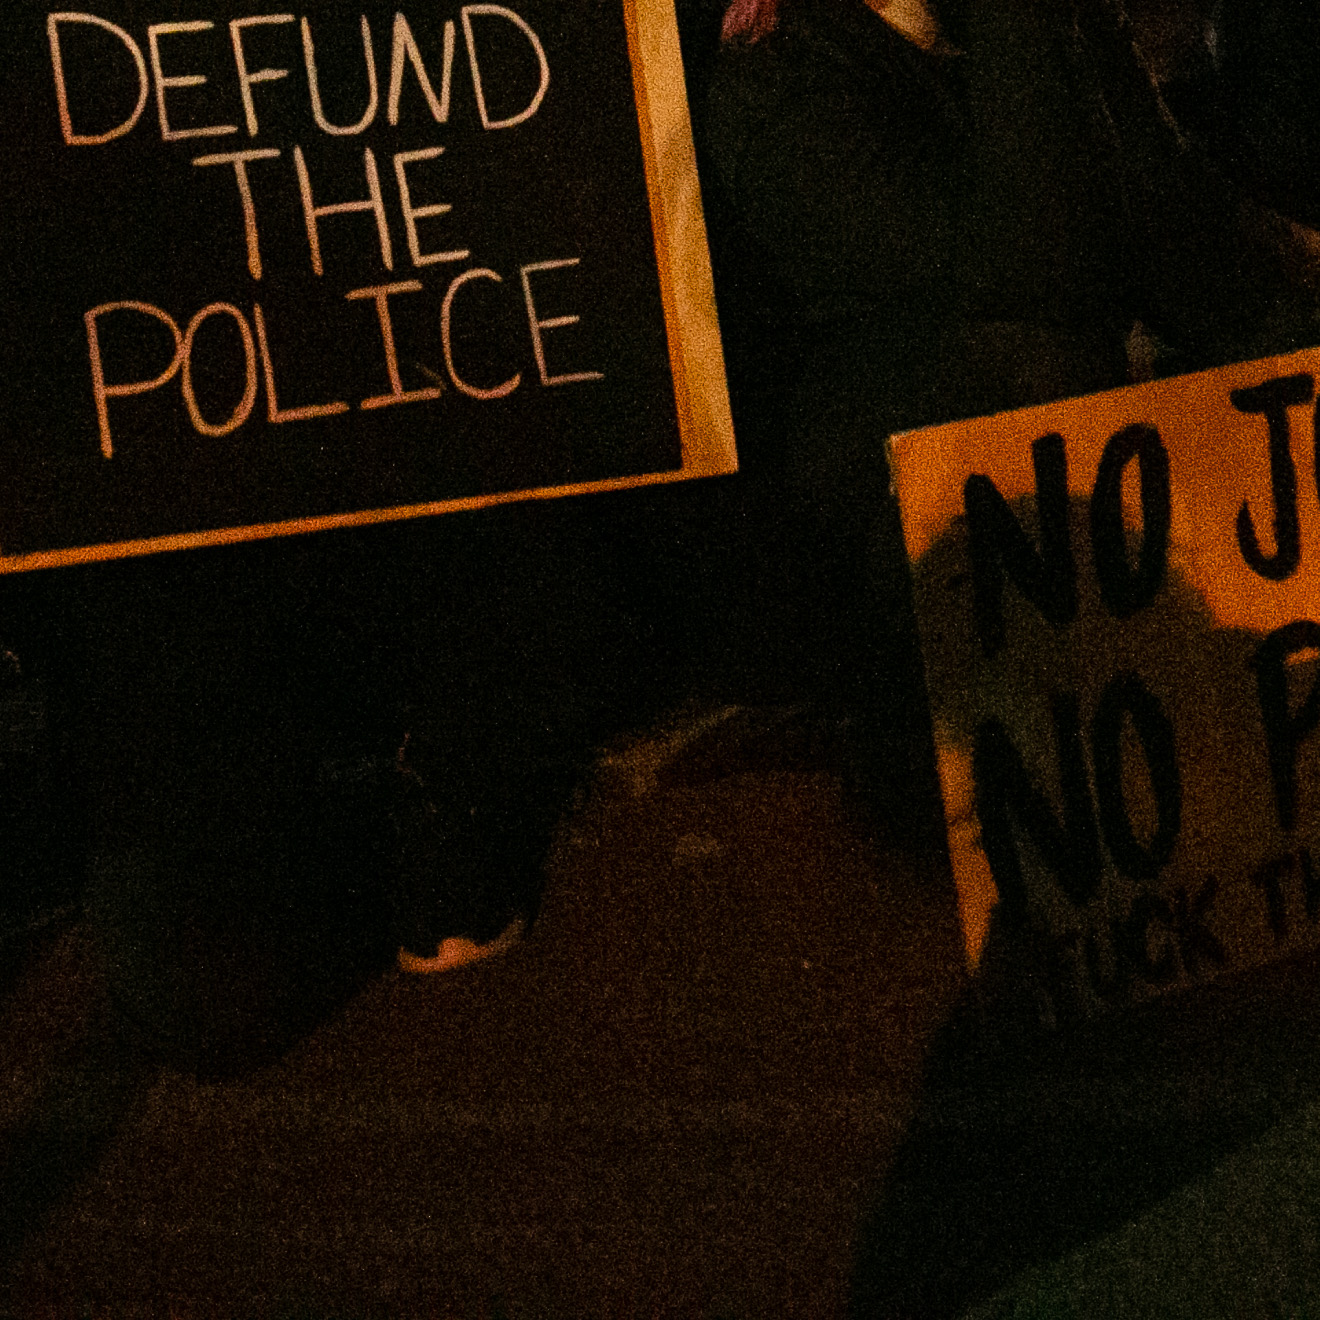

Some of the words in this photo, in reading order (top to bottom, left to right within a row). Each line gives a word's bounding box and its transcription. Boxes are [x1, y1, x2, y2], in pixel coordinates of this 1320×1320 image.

[46, 5, 551, 145] DEFUND
[191, 147, 470, 280] THE
[85, 258, 605, 460] POLICE
[966, 423, 1171, 659] NO
[974, 676, 1182, 930] NO
